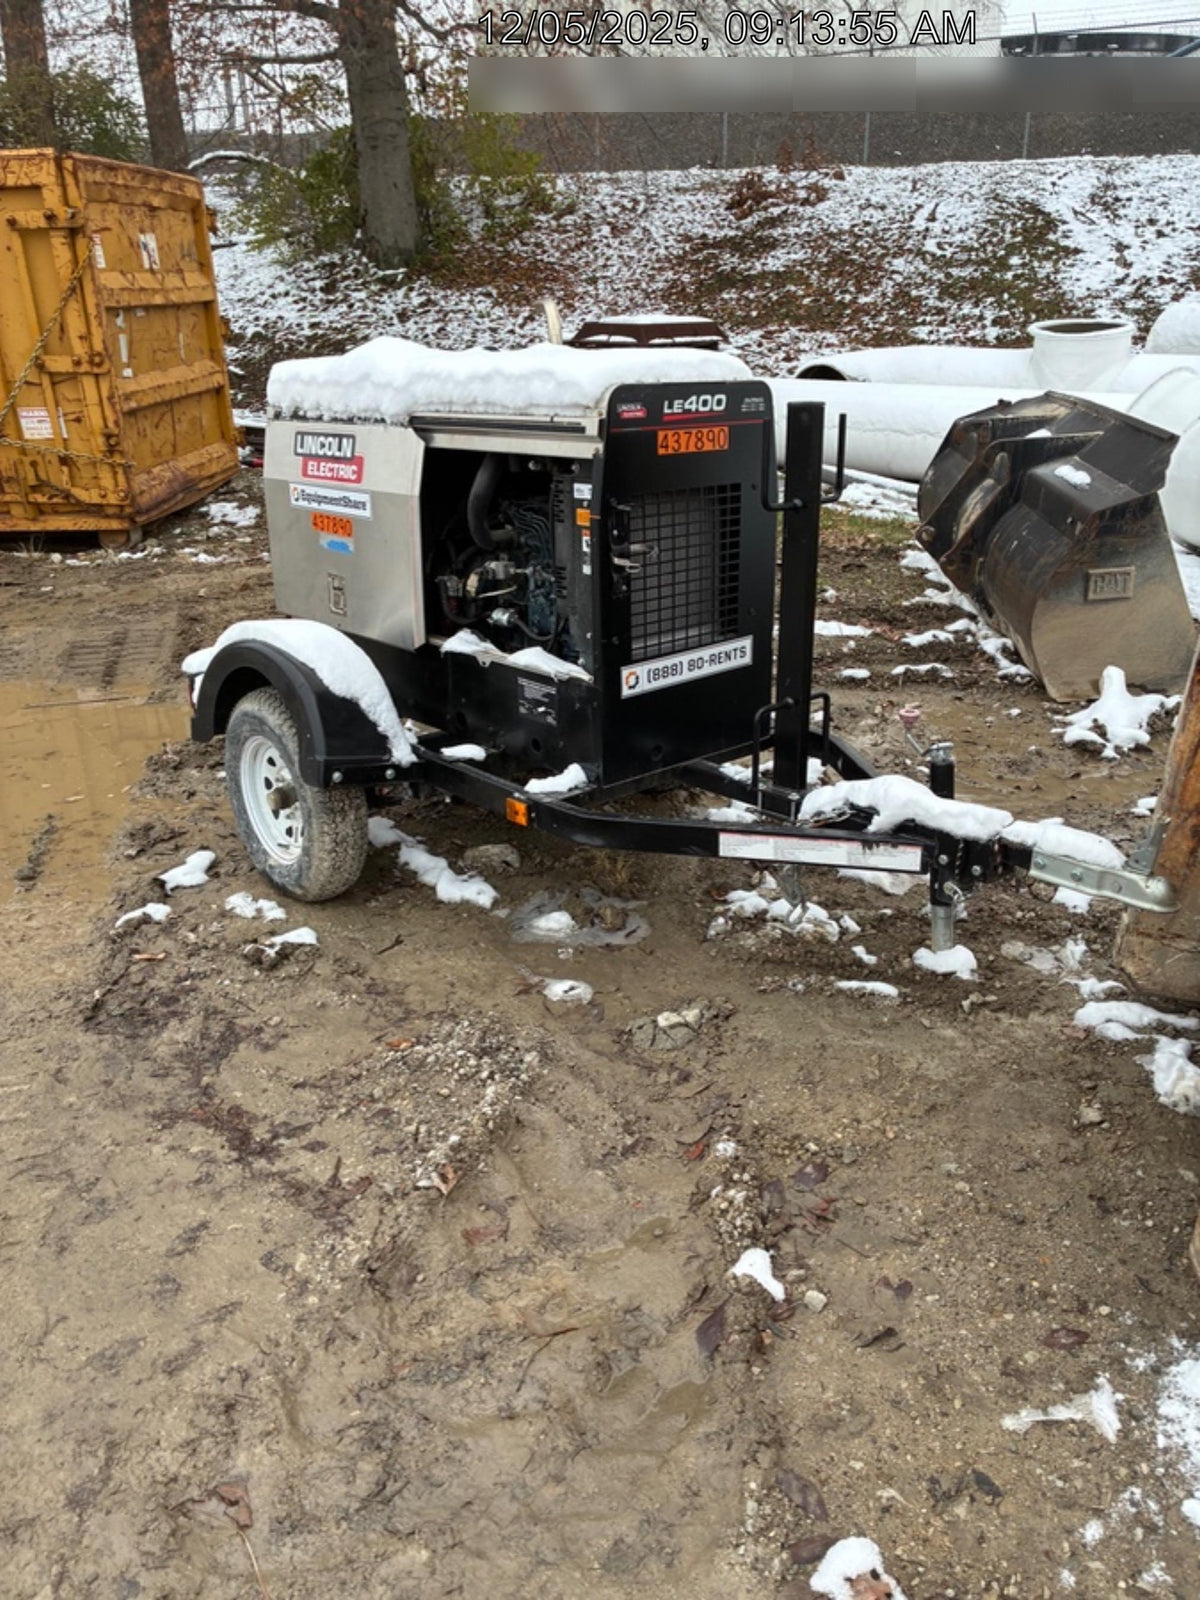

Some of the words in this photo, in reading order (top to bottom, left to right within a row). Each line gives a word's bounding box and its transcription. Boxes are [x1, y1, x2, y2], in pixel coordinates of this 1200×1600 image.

[663, 394, 726, 413] LE400
[297, 434, 353, 457] LINCOLN
[660, 428, 728, 452] 437890
[307, 461, 357, 479] ELECTRIC
[301, 489, 366, 511] EquipmentShare
[313, 514, 352, 537] 437890
[646, 661, 683, 683] (888)
[687, 646, 747, 672] 80-RENTS
